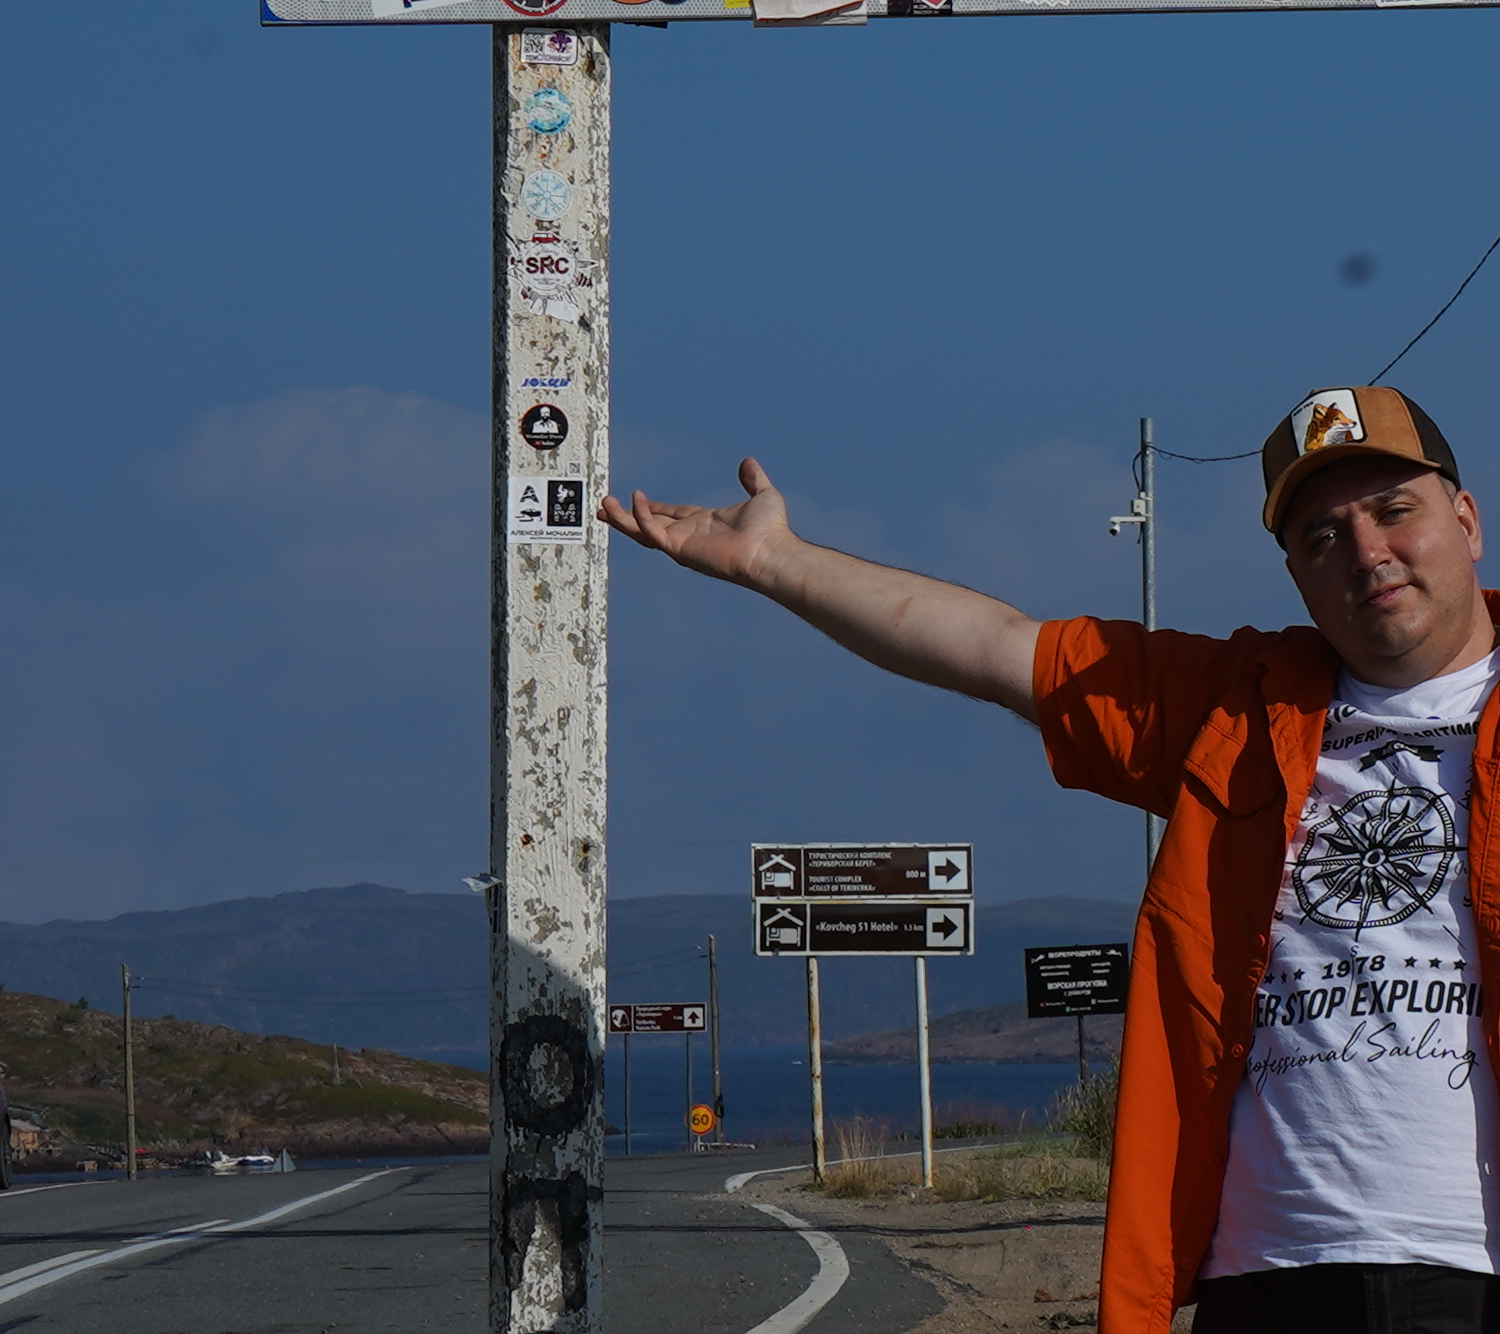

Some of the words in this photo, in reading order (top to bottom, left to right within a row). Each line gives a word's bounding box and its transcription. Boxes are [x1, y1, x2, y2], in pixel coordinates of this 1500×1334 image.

[526, 255, 569, 274] SRC
[815, 921, 857, 934] «Kovcheg
[858, 922, 869, 932] 51
[870, 921, 899, 932] Hotel»
[913, 923, 924, 932] km
[1322, 954, 1385, 980] 1978
[1281, 984, 1346, 1027] STOP
[1351, 979, 1482, 1017] EXPLORI
[1366, 1018, 1478, 1090] Sailing
[692, 1114, 709, 1126] 60
